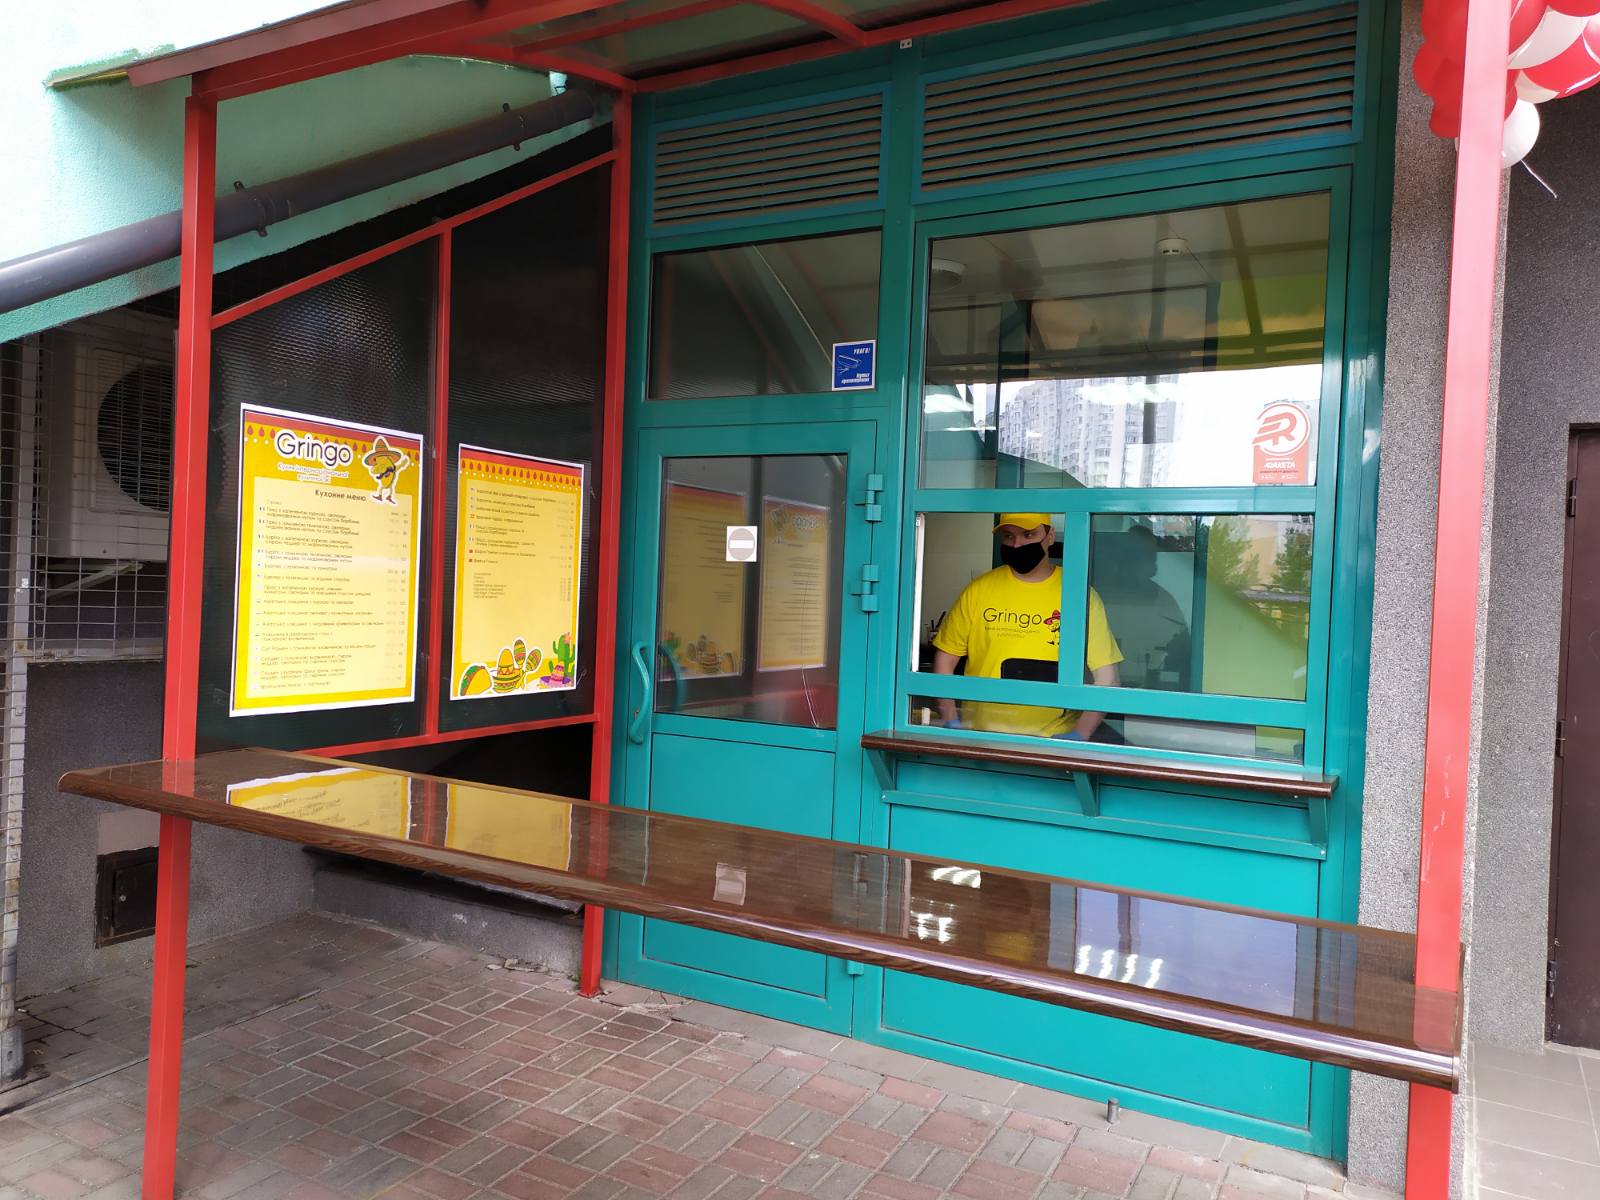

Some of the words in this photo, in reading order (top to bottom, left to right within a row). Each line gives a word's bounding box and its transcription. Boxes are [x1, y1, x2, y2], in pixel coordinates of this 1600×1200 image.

[276, 432, 351, 466] Gringo
[346, 494, 367, 502] меню
[983, 607, 1042, 628] Gringo
